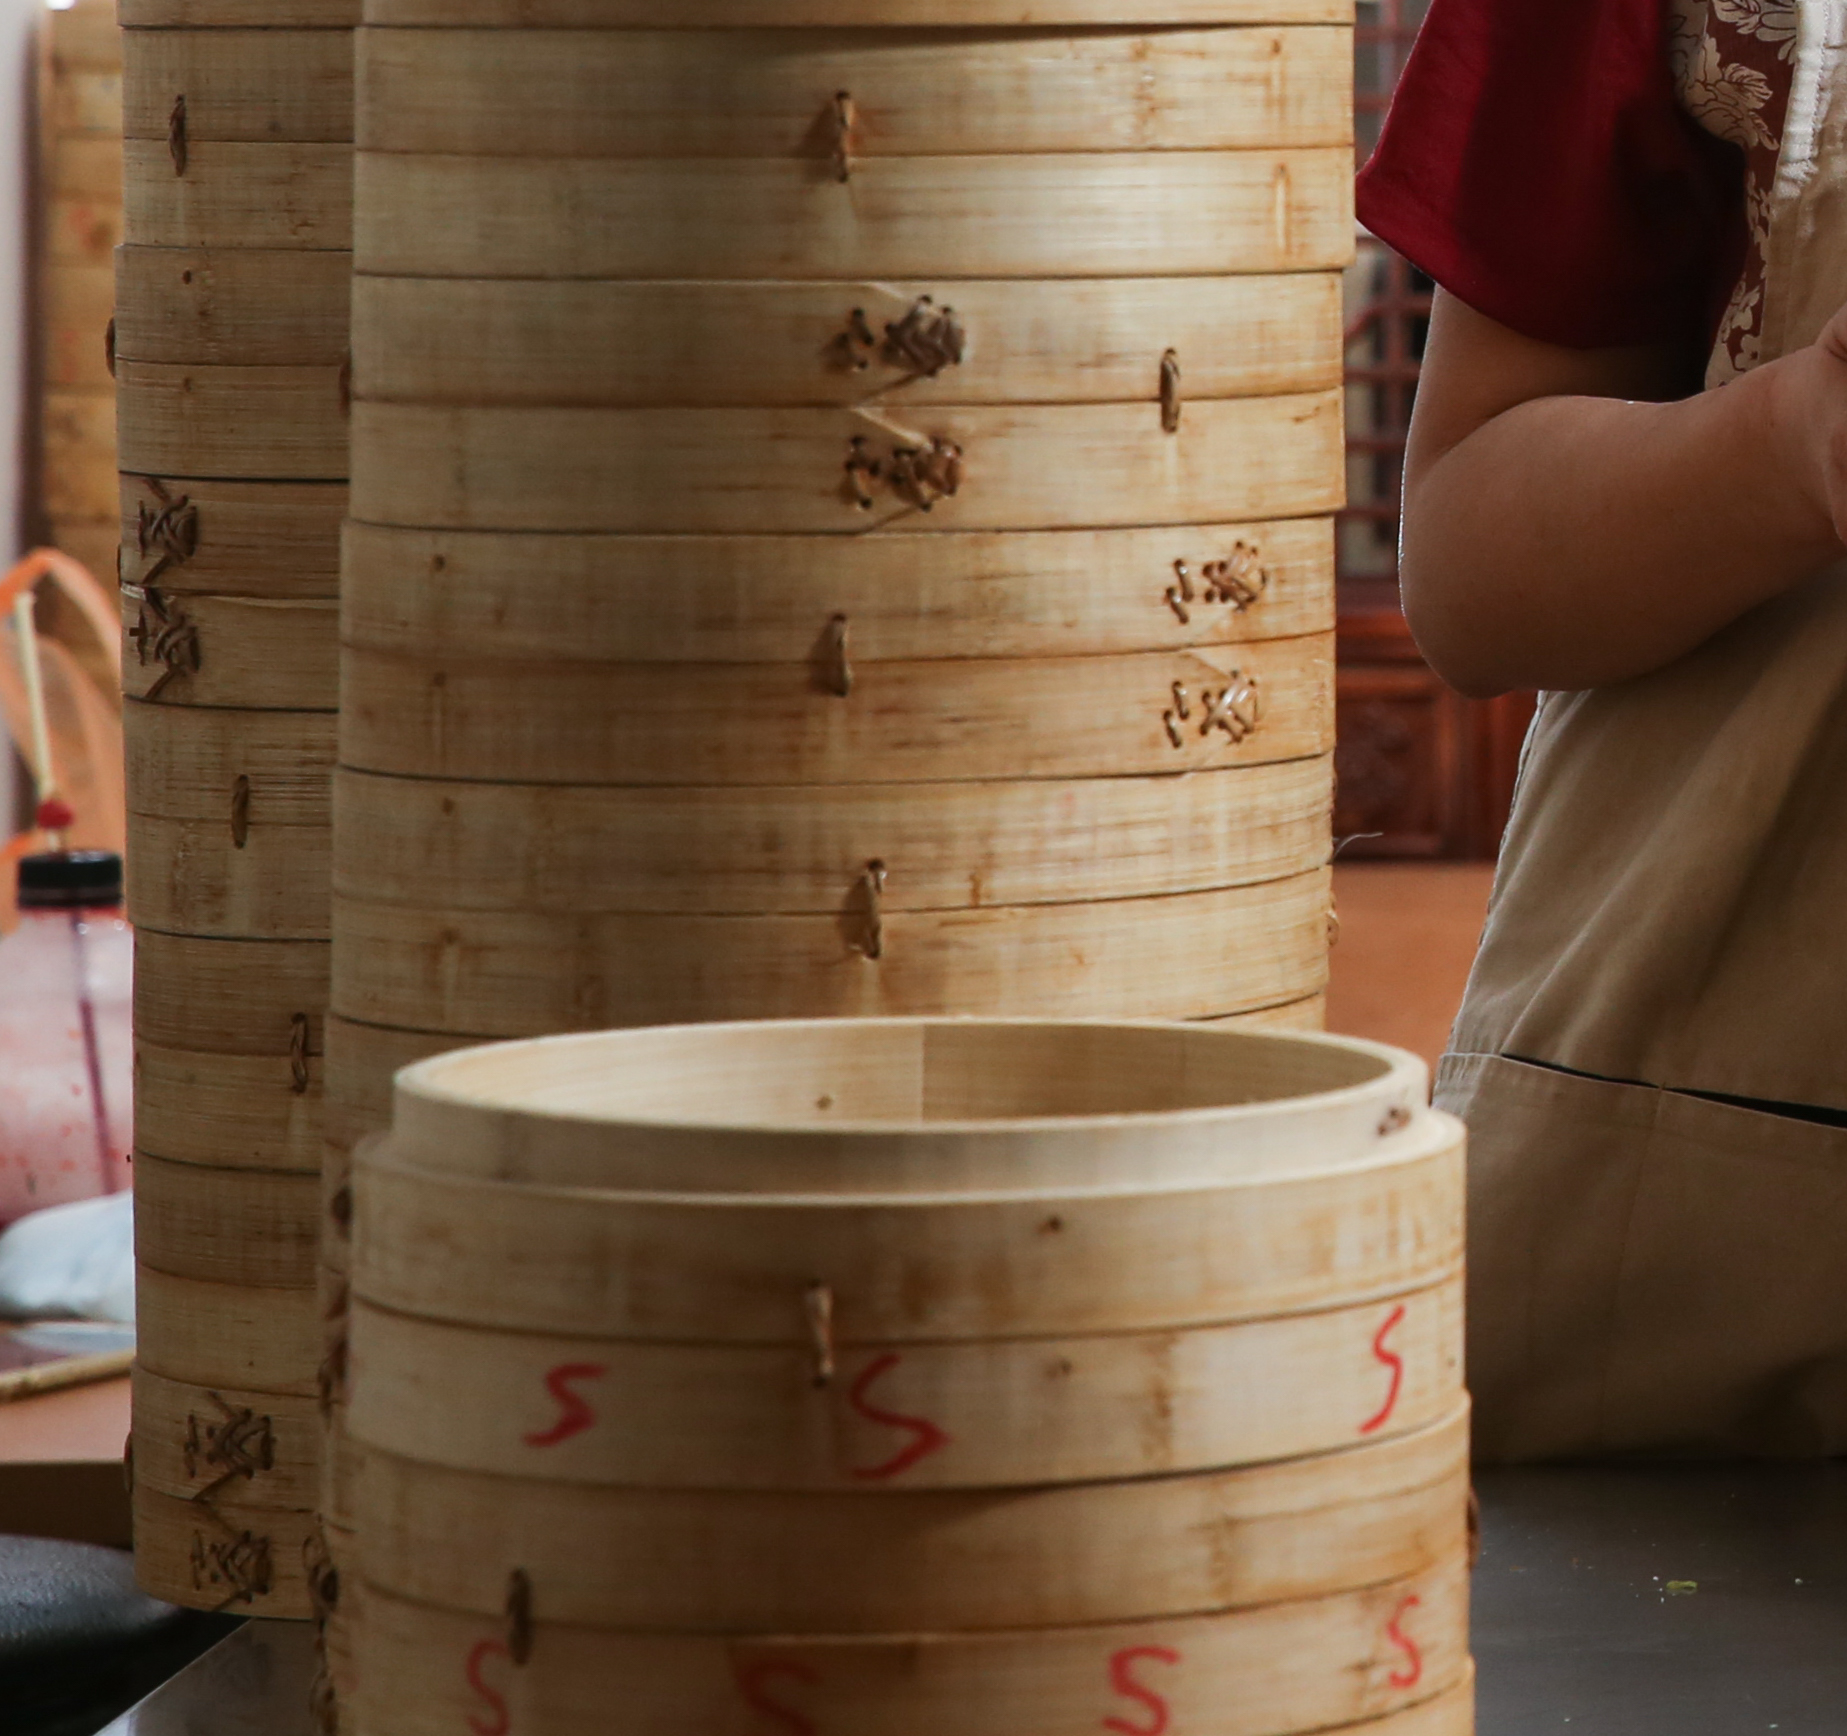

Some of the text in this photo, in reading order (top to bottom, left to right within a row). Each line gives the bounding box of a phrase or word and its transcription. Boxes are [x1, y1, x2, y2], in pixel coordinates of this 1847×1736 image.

[522, 1306, 1406, 1480] S S S
[464, 1637, 512, 1735] S
[1103, 1644, 1181, 1735] S
[1384, 1595, 1423, 1690] S
